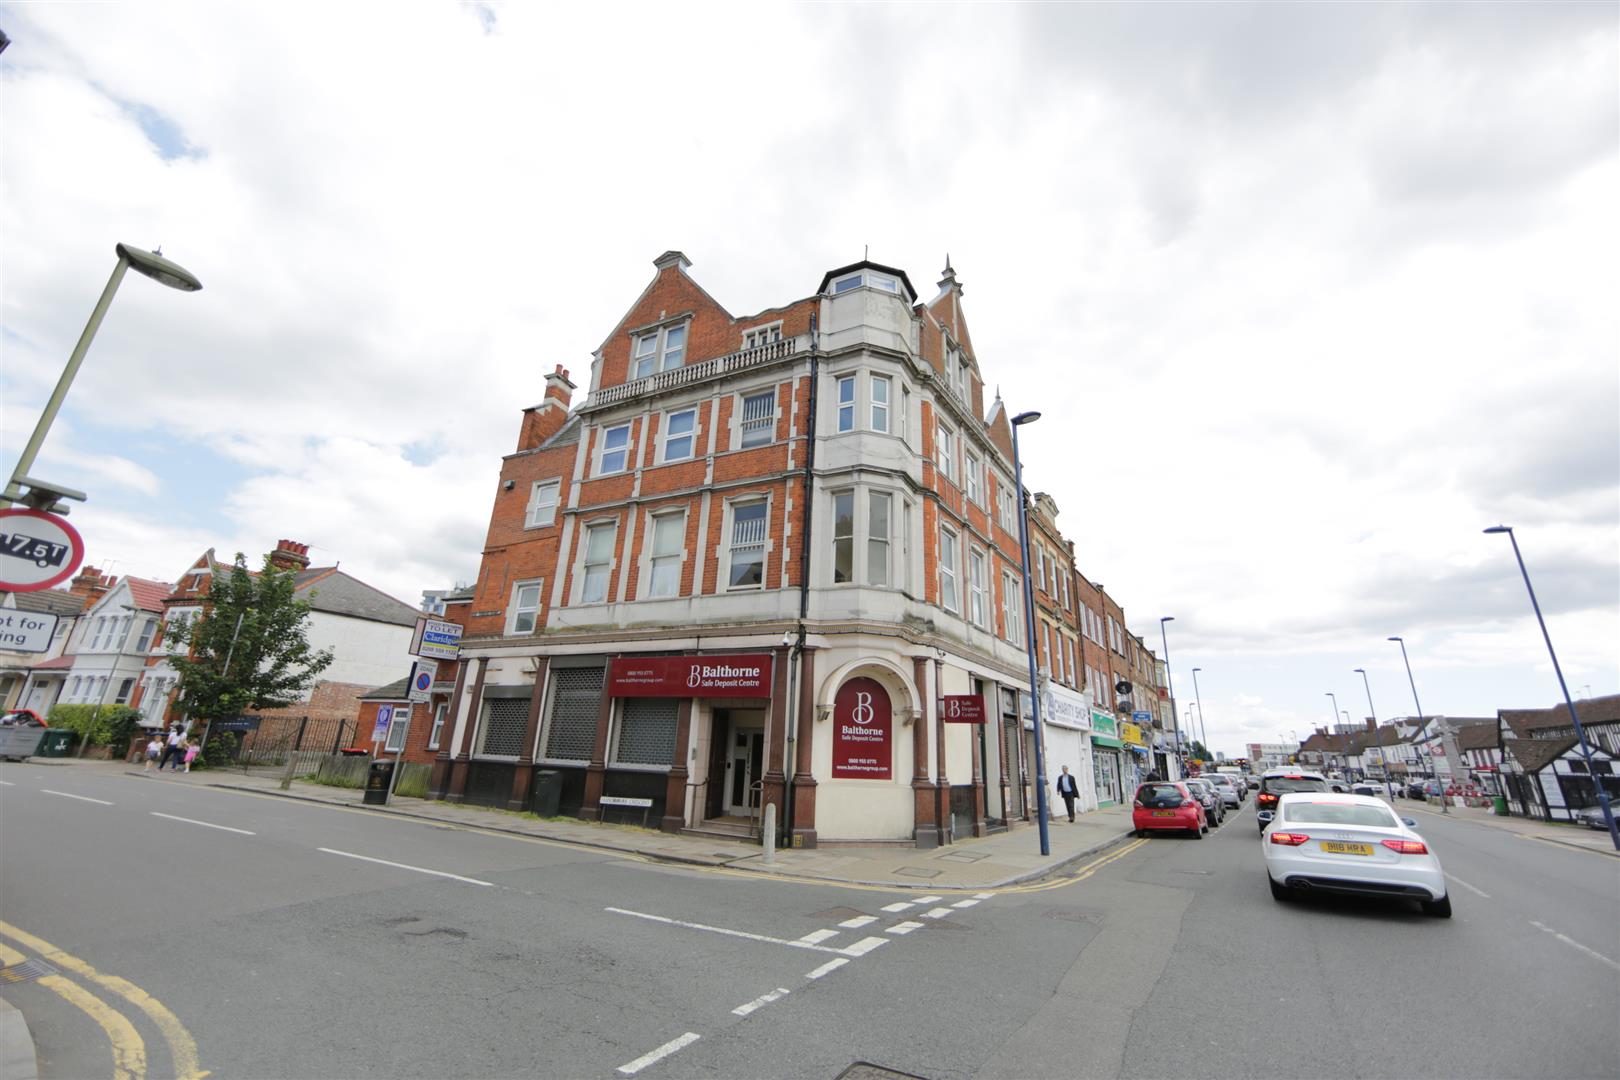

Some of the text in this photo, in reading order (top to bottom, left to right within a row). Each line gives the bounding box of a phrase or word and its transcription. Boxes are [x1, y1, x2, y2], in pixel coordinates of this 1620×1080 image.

[20, 617, 46, 630] for
[442, 627, 458, 635] LET
[702, 665, 760, 678] Balthorne
[714, 680, 737, 688] Deposit
[738, 679, 760, 687] Centre
[1054, 699, 1087, 721] CHARITY SHOP
[842, 726, 884, 736] Balthorne
[852, 735, 869, 743] Deposit
